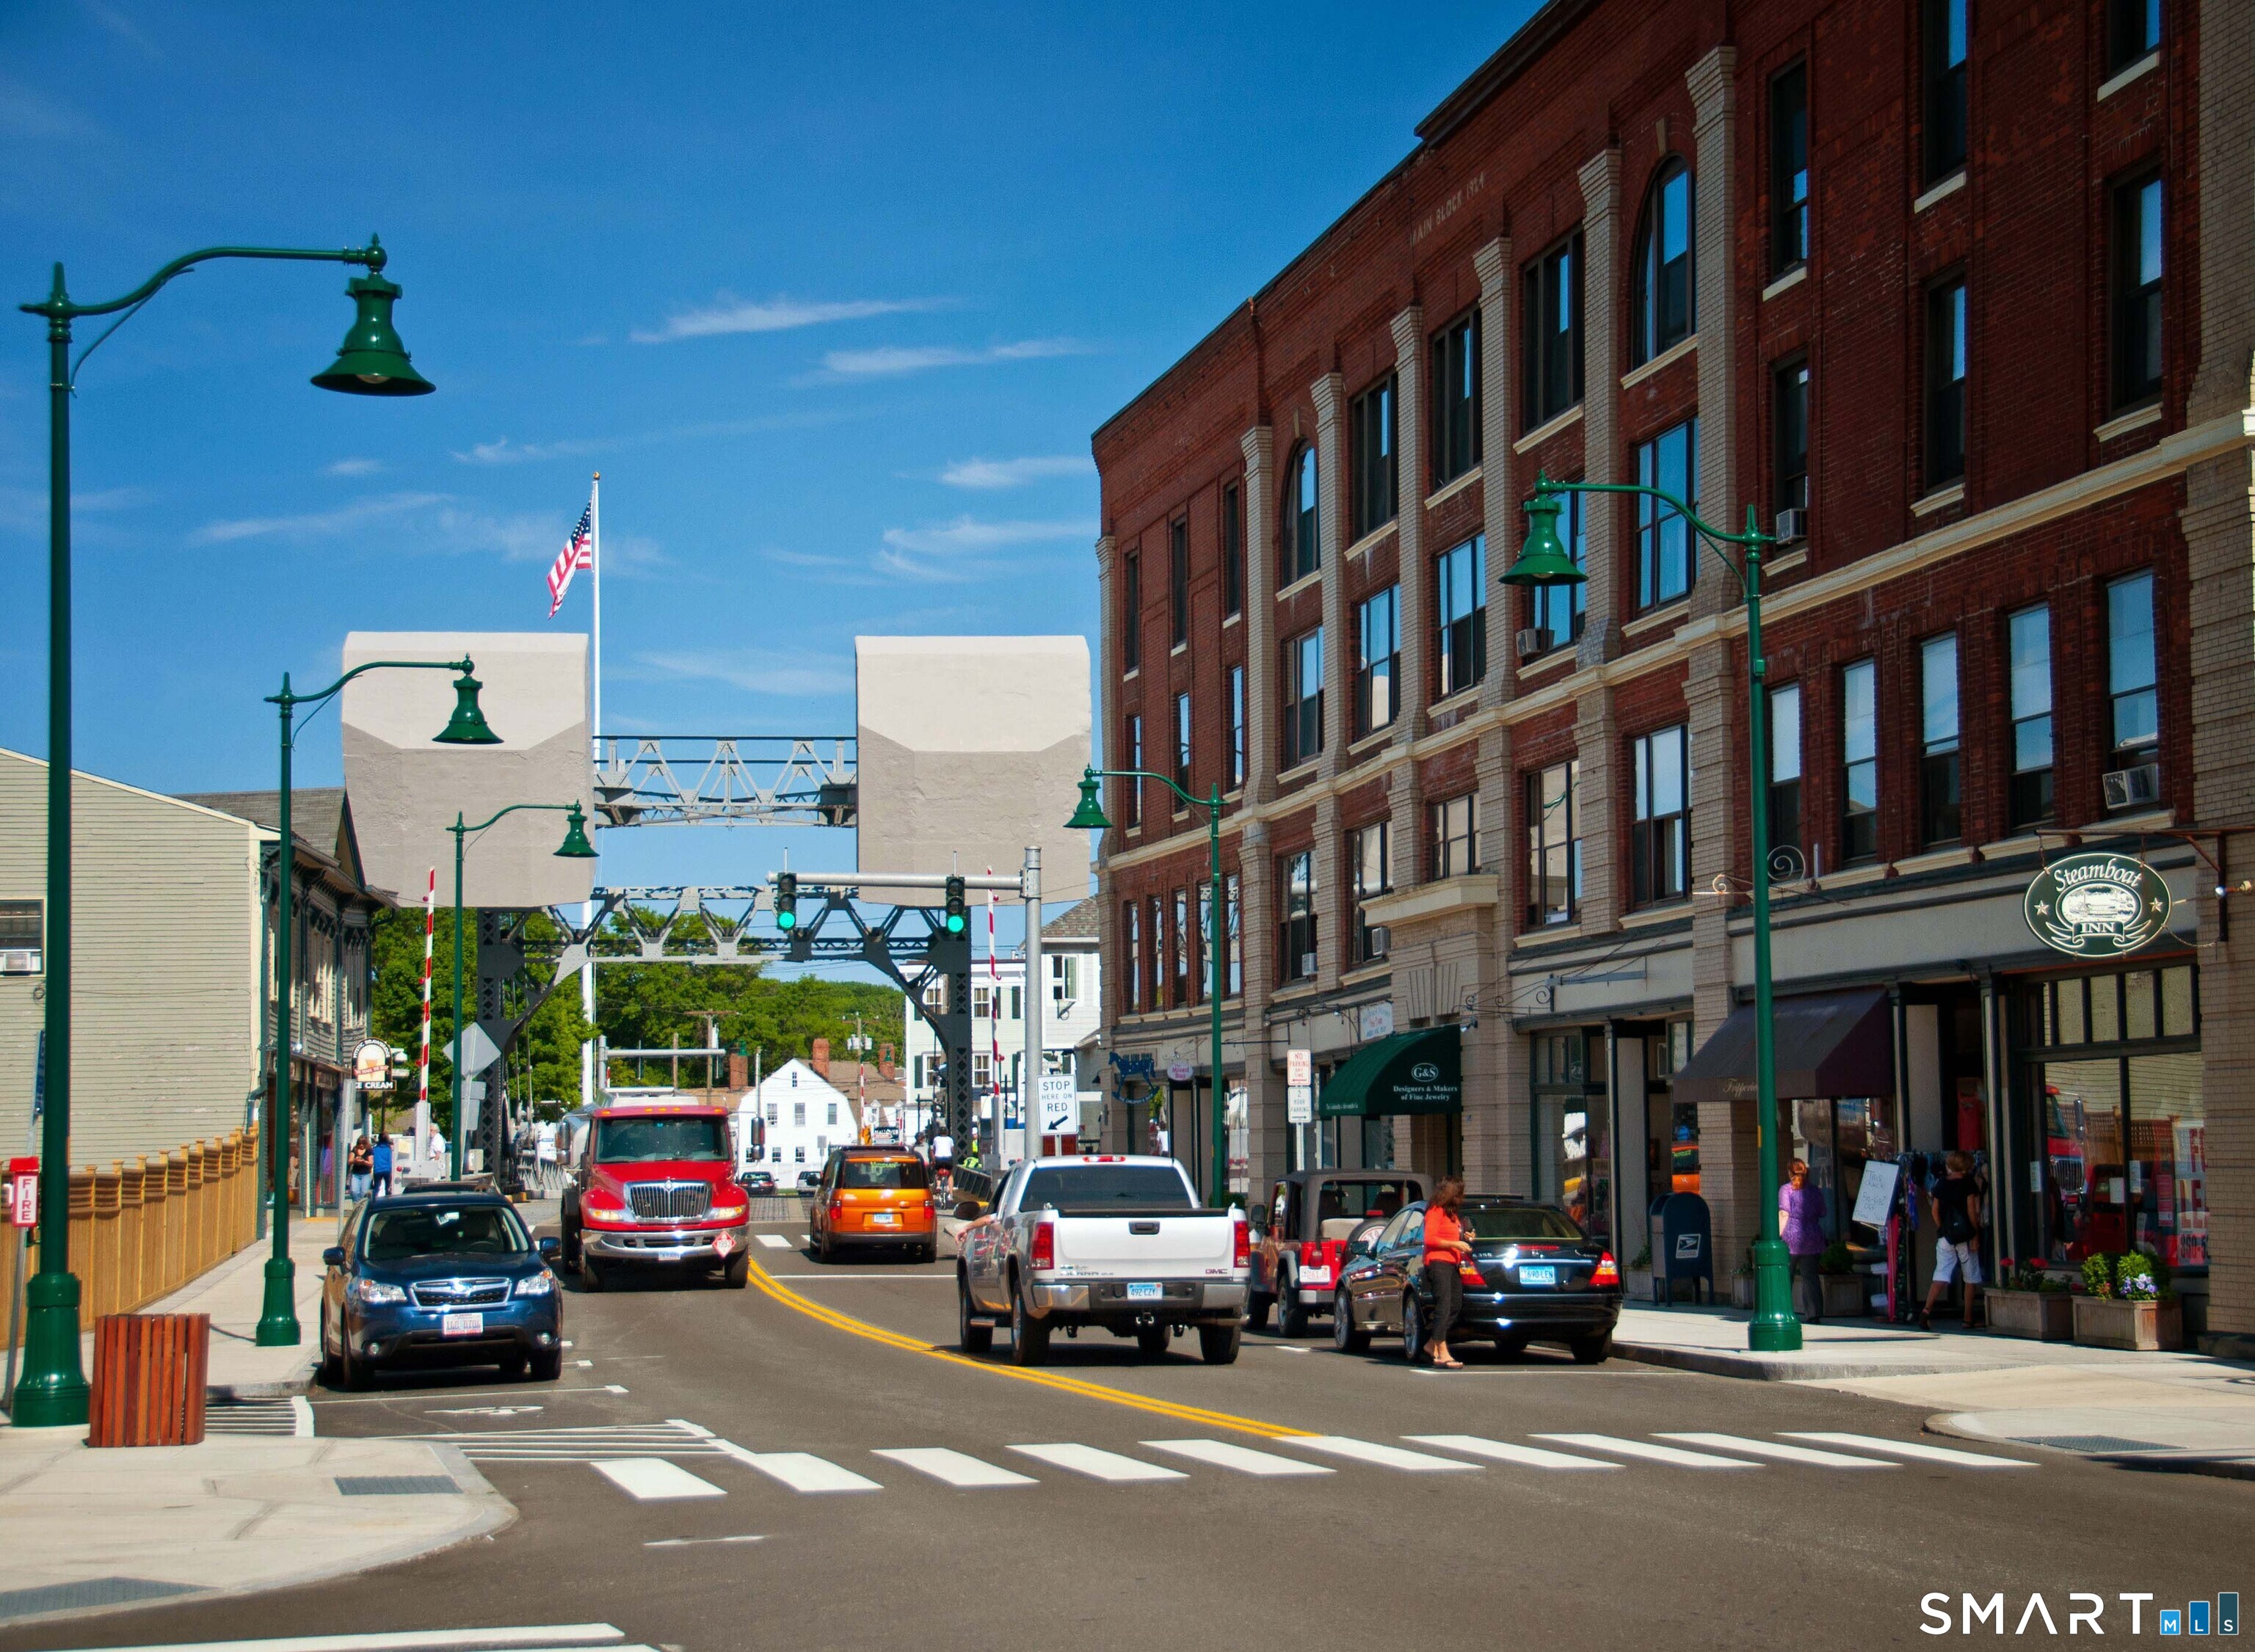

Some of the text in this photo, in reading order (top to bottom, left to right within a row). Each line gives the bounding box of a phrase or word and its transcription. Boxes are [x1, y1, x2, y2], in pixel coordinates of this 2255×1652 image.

[1437, 190, 1462, 225] BLOCK
[2054, 857, 2142, 892] Steamboat
[2080, 922, 2116, 934] INN
[1413, 1067, 1437, 1078] G&S
[1042, 1081, 1070, 1091] STOP
[1297, 1089, 1301, 1098] 2
[1424, 1094, 1450, 1102] Jewelry
[1047, 1102, 1068, 1113] RED
[21, 1179, 32, 1221] FIRE
